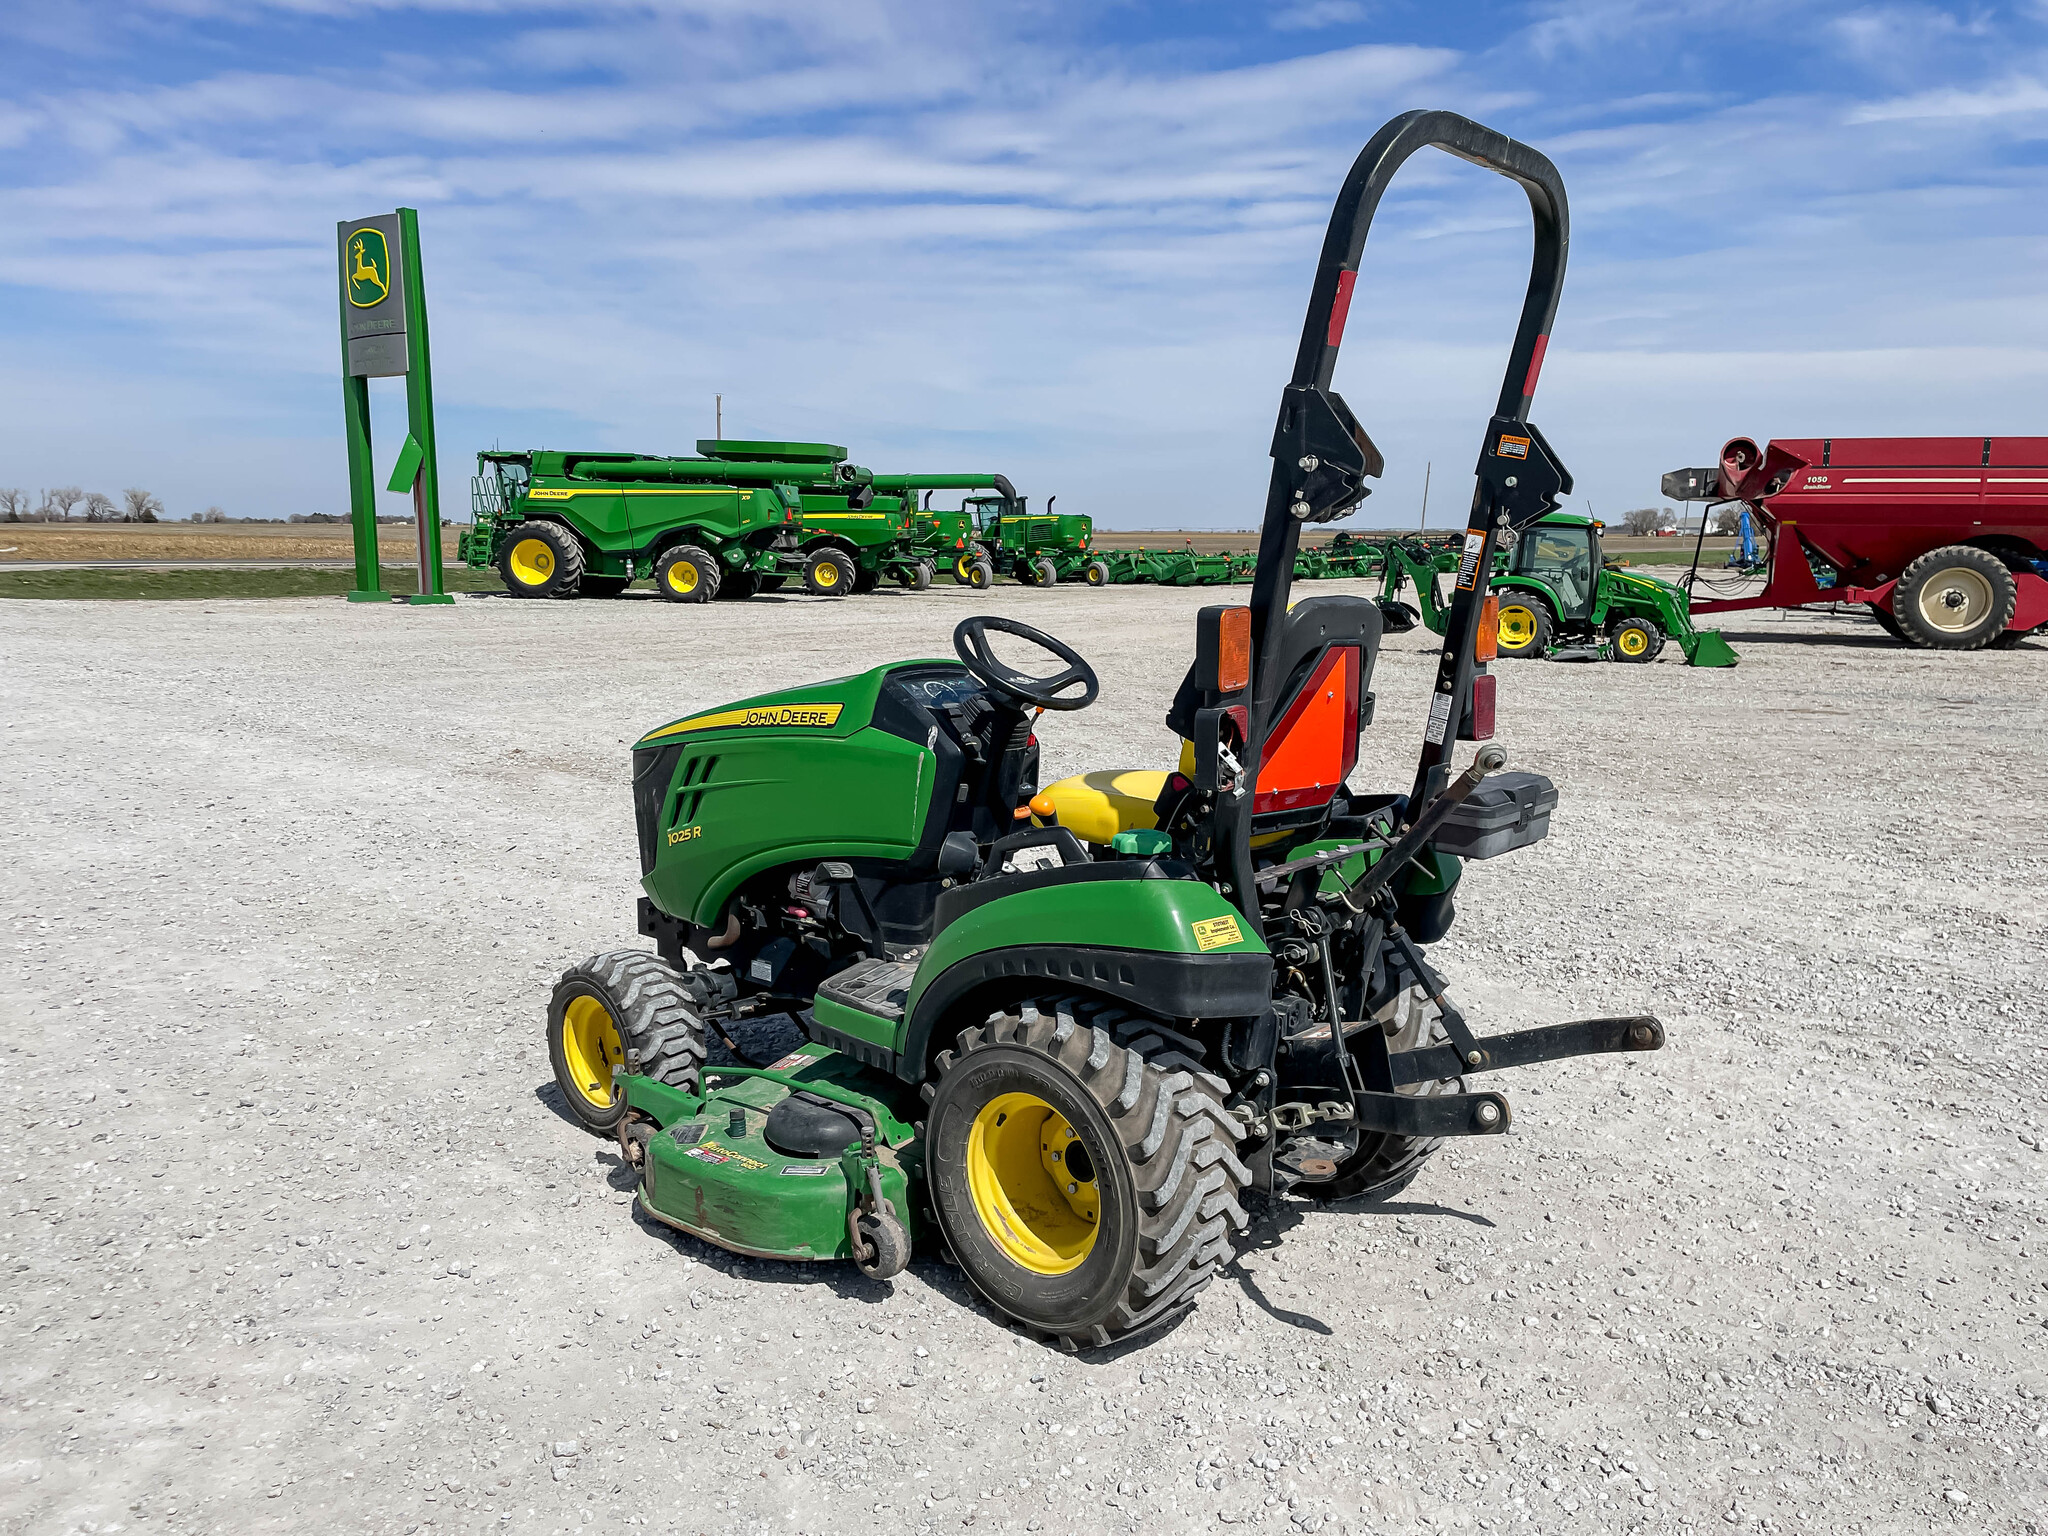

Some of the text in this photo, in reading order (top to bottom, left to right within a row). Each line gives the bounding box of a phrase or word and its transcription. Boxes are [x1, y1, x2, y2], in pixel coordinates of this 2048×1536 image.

[1506, 436, 1529, 444] WARNING
[1807, 476, 1828, 484] 1050
[740, 708, 829, 725] JOHN DEERE
[667, 825, 702, 847] 1025 R
[936, 1173, 1024, 1302] CARLISLE
